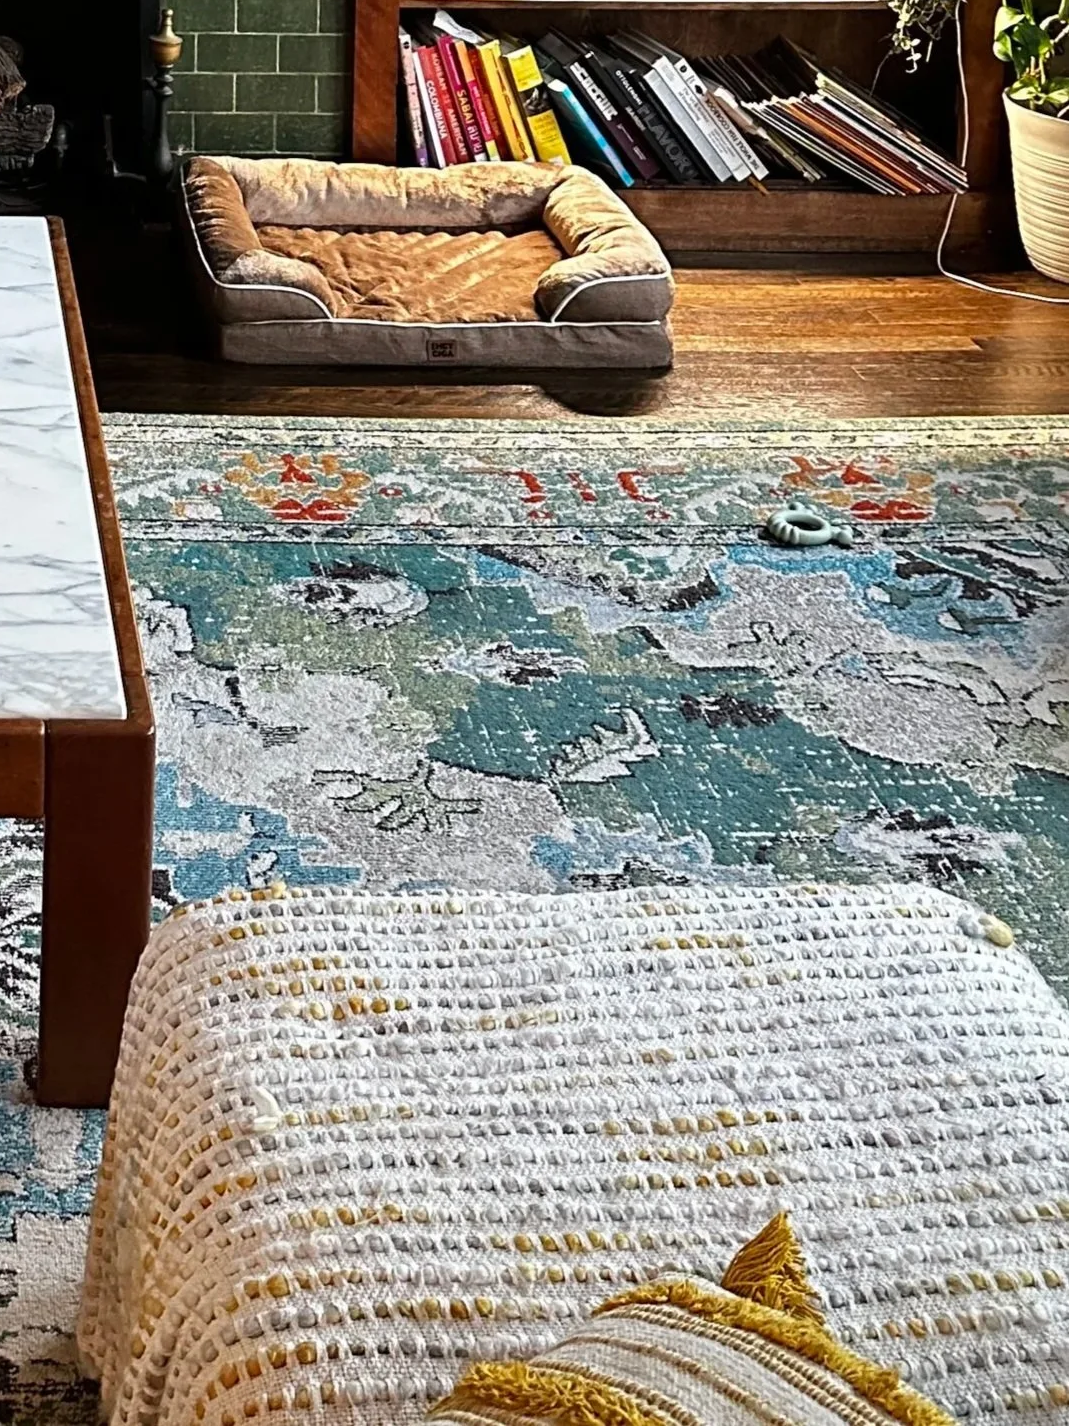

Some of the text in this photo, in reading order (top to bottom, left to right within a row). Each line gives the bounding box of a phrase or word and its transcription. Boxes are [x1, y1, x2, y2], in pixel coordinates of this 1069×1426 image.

[432, 53, 448, 91] KOREAN
[615, 69, 643, 106] OTTOLENGHI
[426, 80, 448, 140] COLOMBIANA
[457, 89, 475, 124] SABAI
[704, 98, 731, 130] COOKBOOK
[447, 108, 468, 155] AMERICAN
[636, 104, 691, 174] FLAVOR
[735, 140, 753, 161] WHOLE
[750, 159, 761, 170] THE
